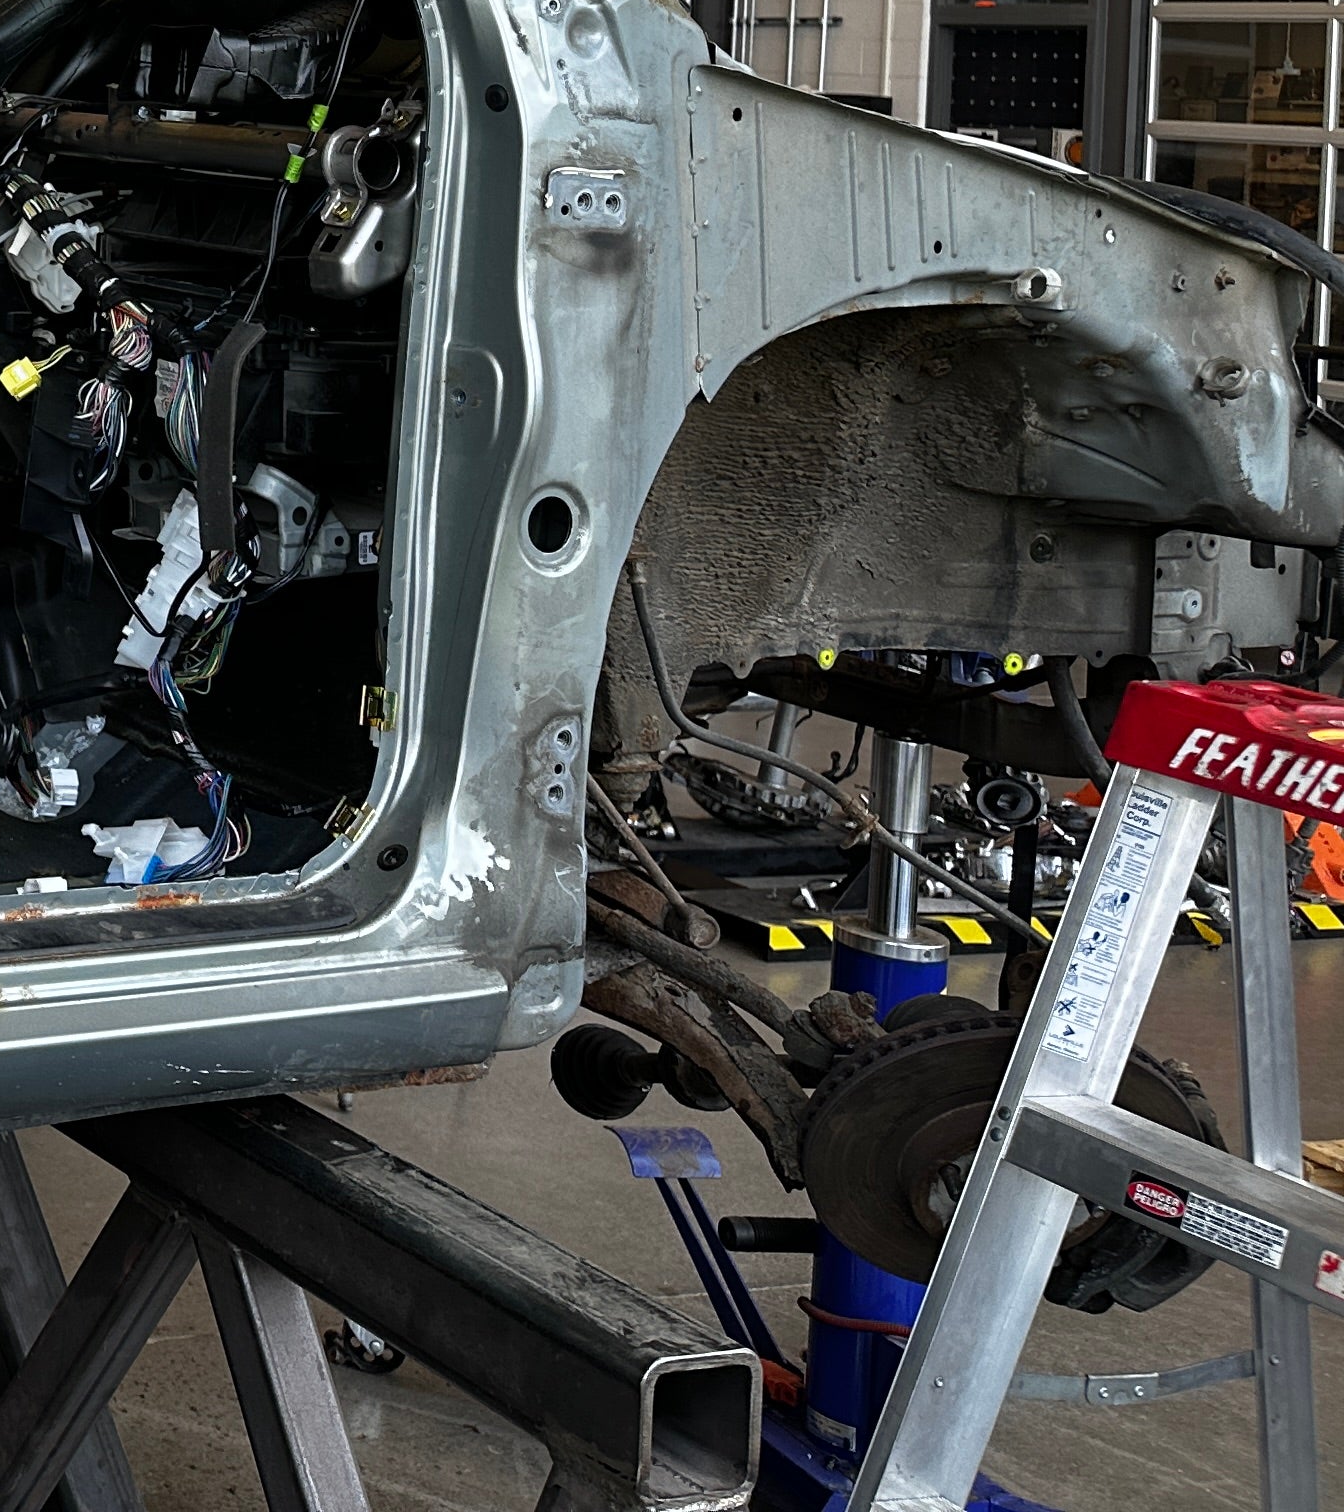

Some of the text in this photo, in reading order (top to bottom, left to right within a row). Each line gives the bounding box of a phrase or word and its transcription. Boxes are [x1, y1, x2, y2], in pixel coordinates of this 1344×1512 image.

[1169, 727, 1344, 815] FEATHE
[1132, 790, 1169, 810] ouisville
[1127, 811, 1152, 827] Corp.
[1133, 1192, 1179, 1216] PELIGRO
[1135, 1182, 1180, 1207] DANGER
